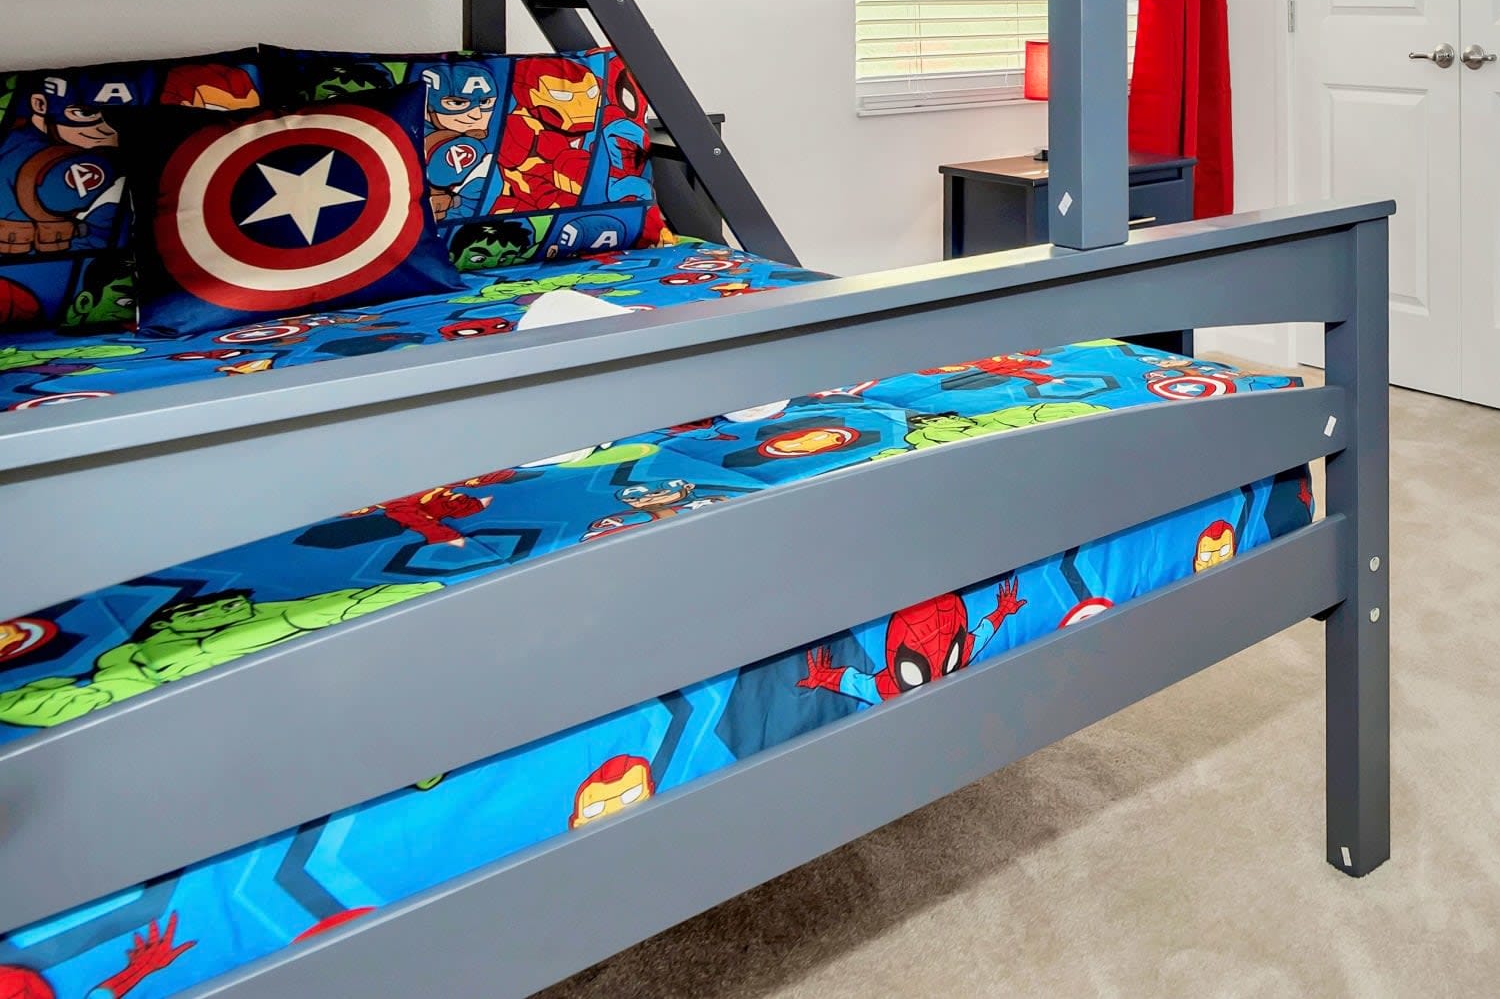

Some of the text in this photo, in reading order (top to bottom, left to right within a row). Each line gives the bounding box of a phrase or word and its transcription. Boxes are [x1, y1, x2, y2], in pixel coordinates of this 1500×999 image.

[93, 82, 133, 103] A
[462, 76, 492, 94] A
[590, 230, 618, 249] A
